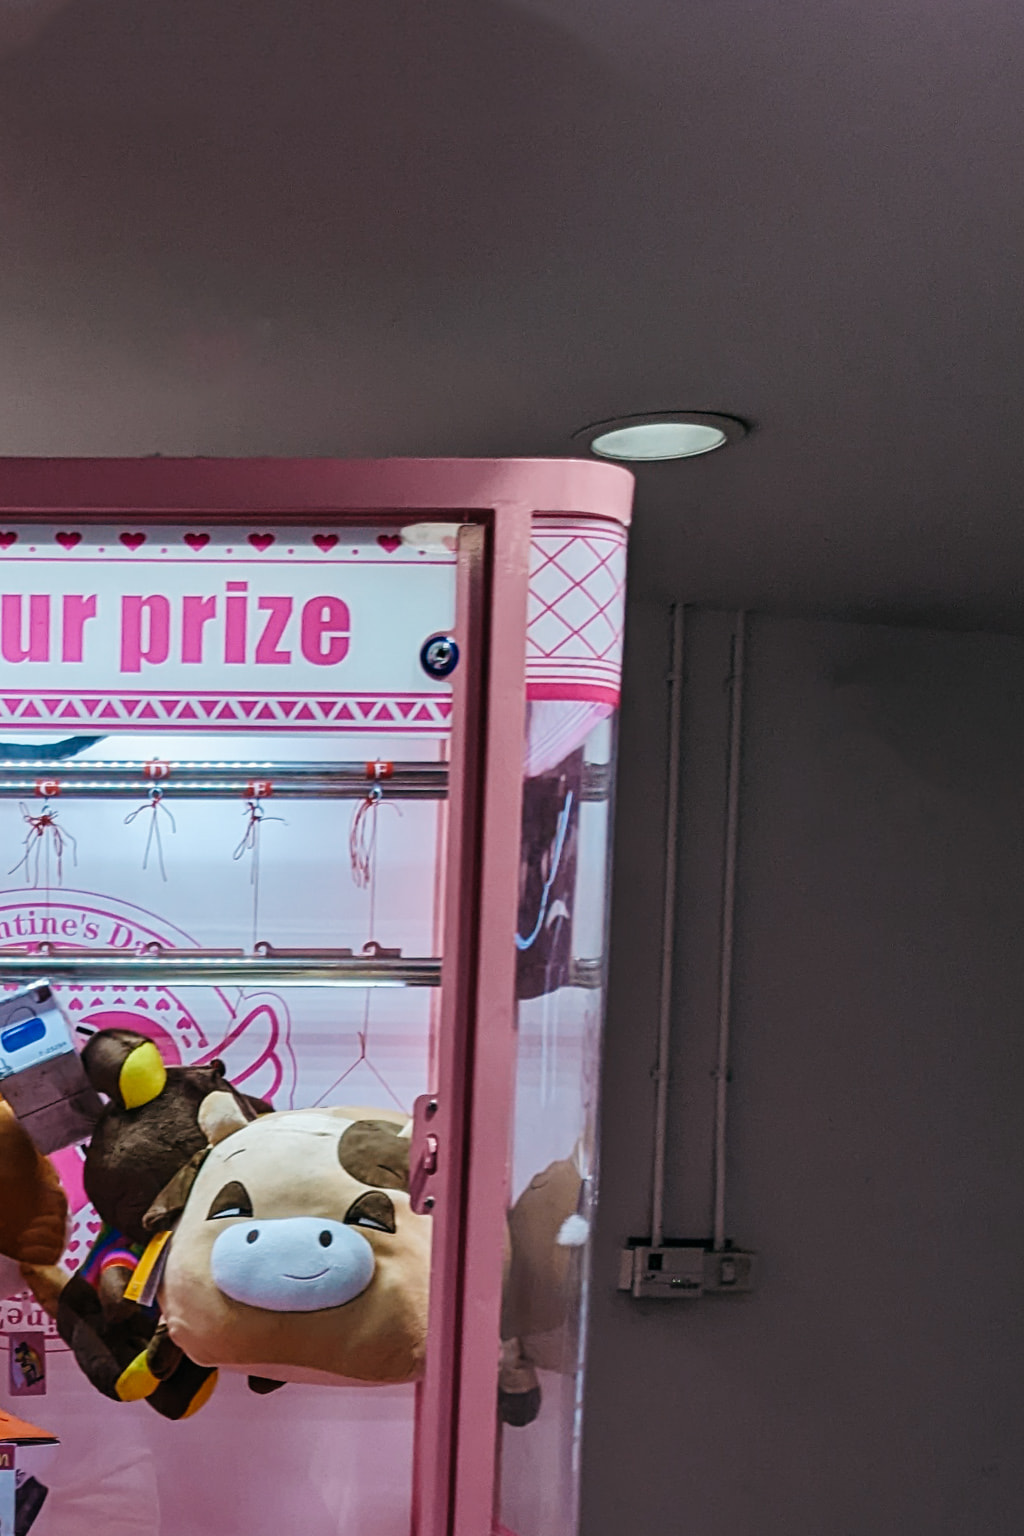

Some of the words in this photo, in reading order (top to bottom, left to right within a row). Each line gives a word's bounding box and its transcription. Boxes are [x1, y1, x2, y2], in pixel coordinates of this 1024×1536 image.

[1, 593, 97, 663] ur
[119, 581, 350, 673] prize
[150, 764, 167, 778] D
[375, 763, 387, 778] F
[39, 781, 56, 796] C
[253, 782, 267, 796] E
